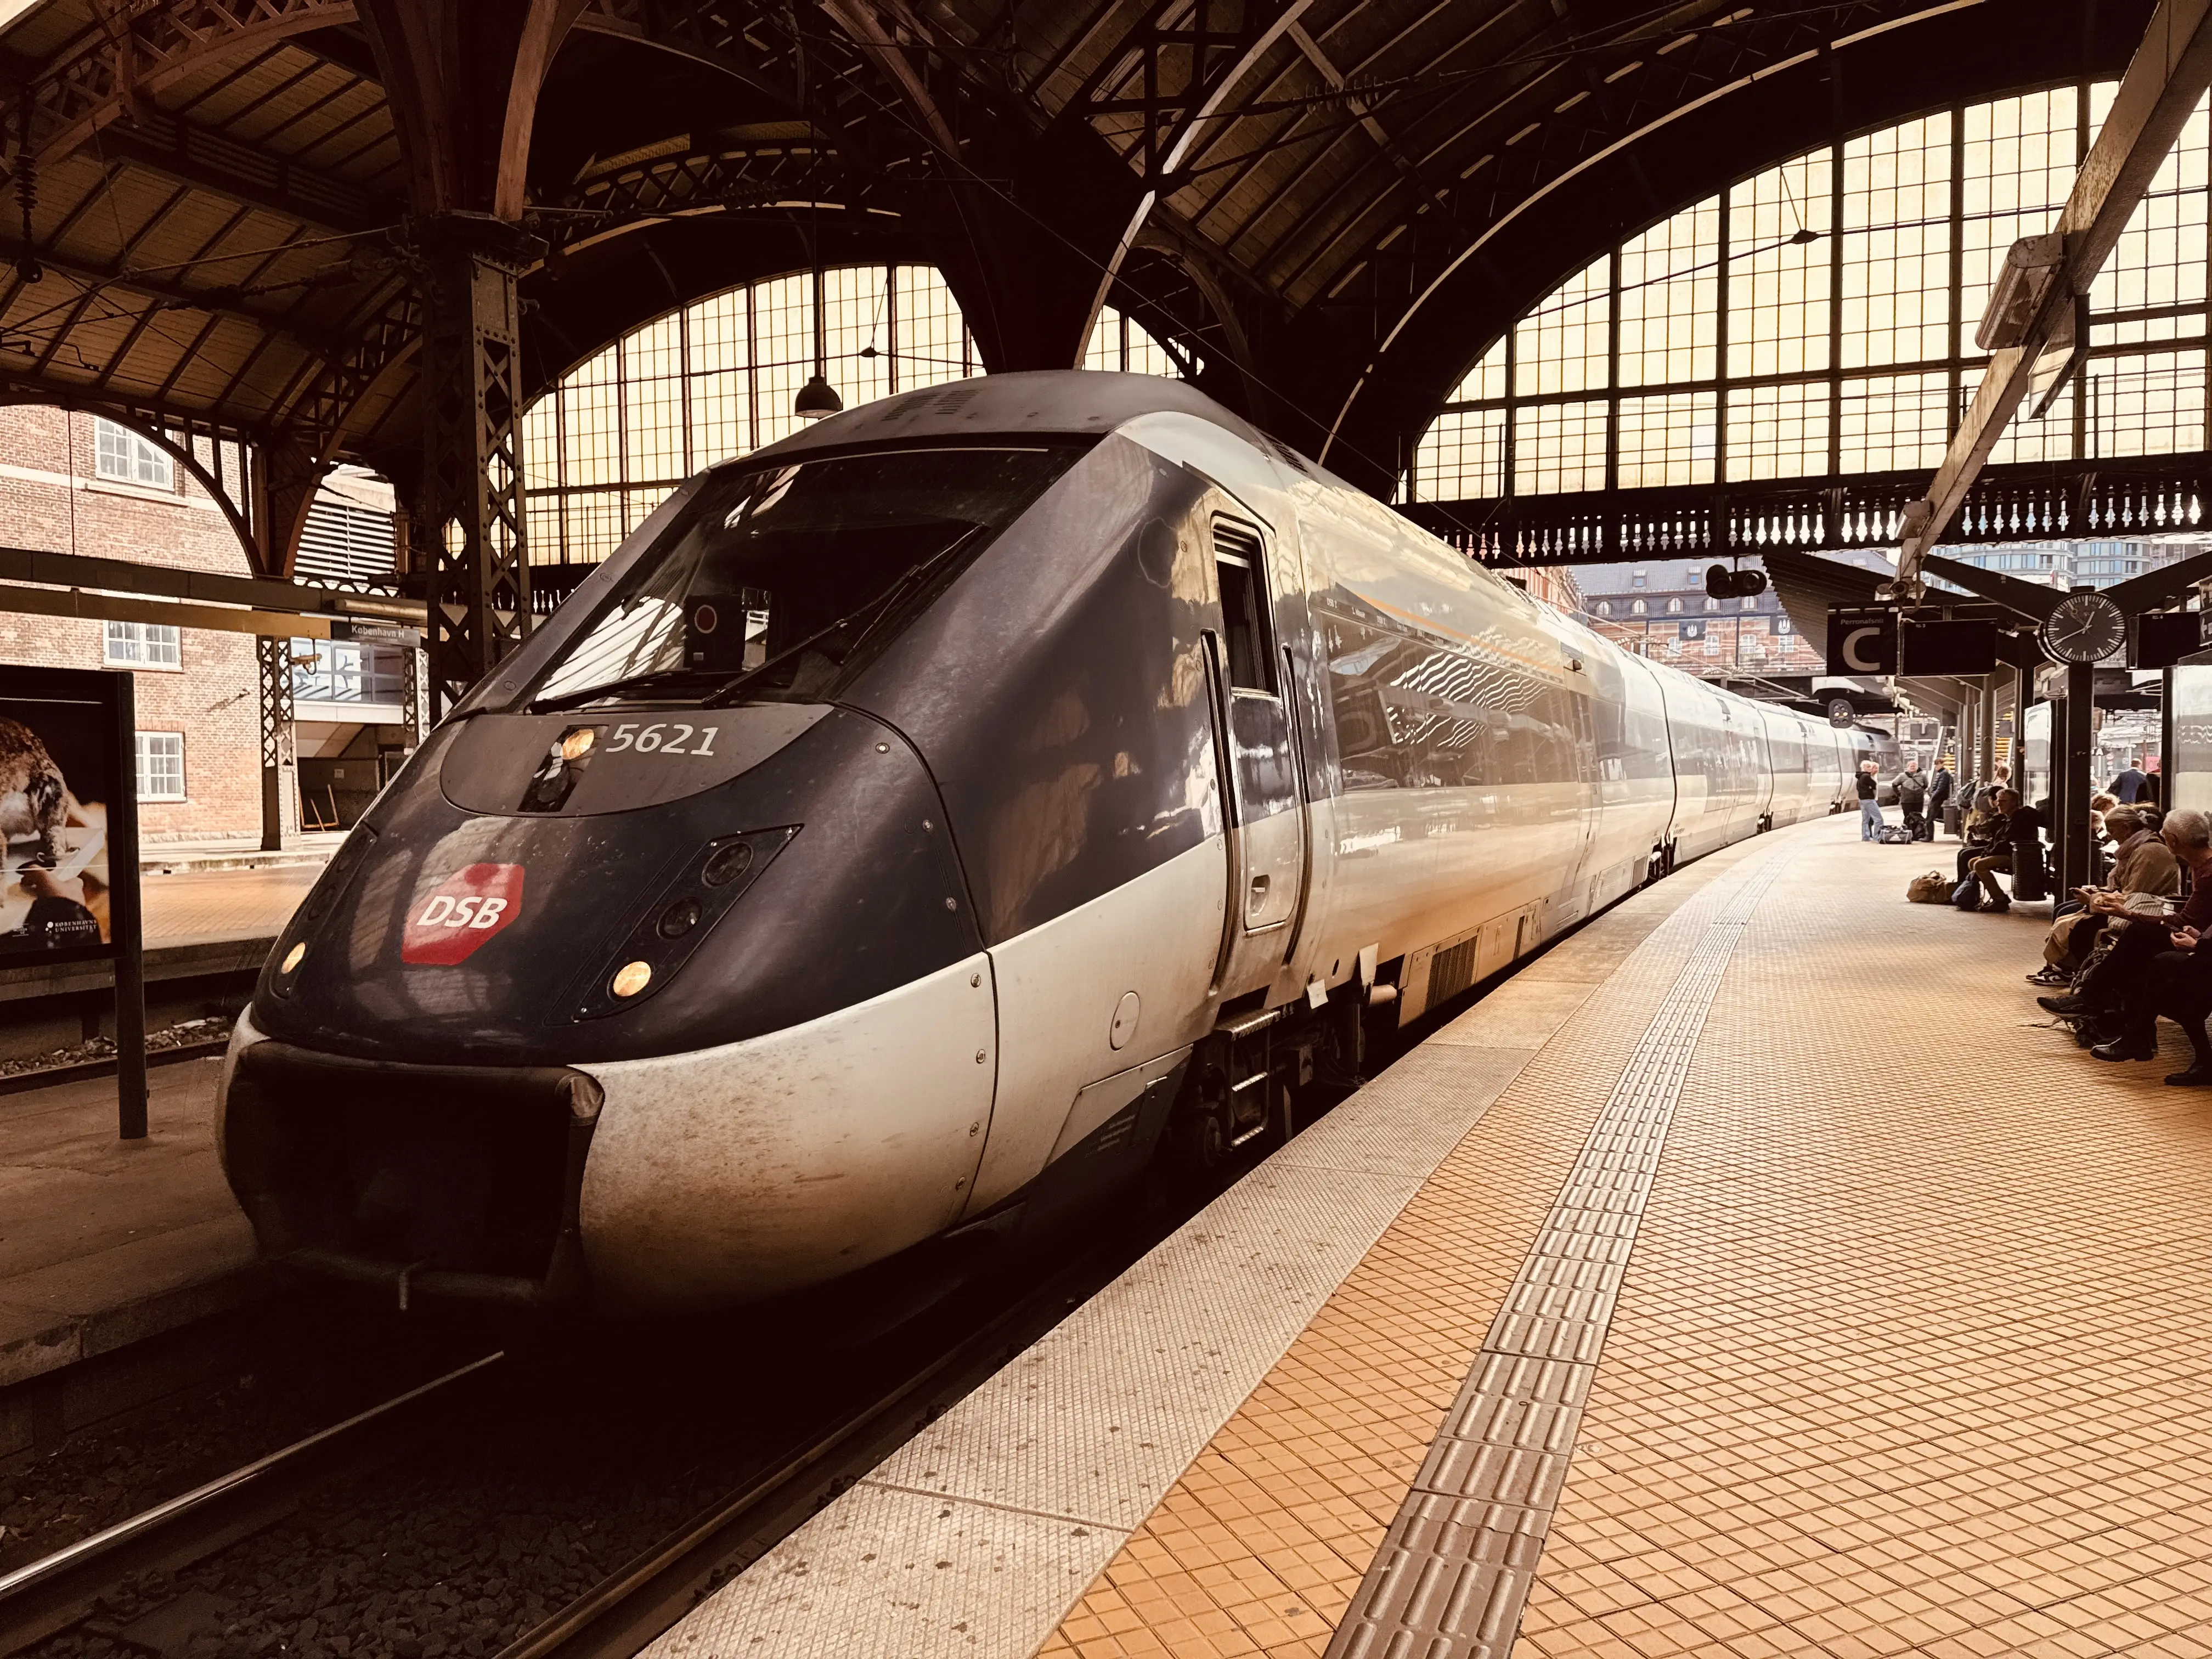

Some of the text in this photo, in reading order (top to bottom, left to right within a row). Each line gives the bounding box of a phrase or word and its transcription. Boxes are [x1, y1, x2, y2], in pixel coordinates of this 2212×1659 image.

[351, 625, 404, 638] København H
[1843, 627, 1880, 672] C
[605, 724, 719, 756] 5621
[416, 895, 507, 929] DSB
[55, 924, 97, 933] UNIVERSITET
